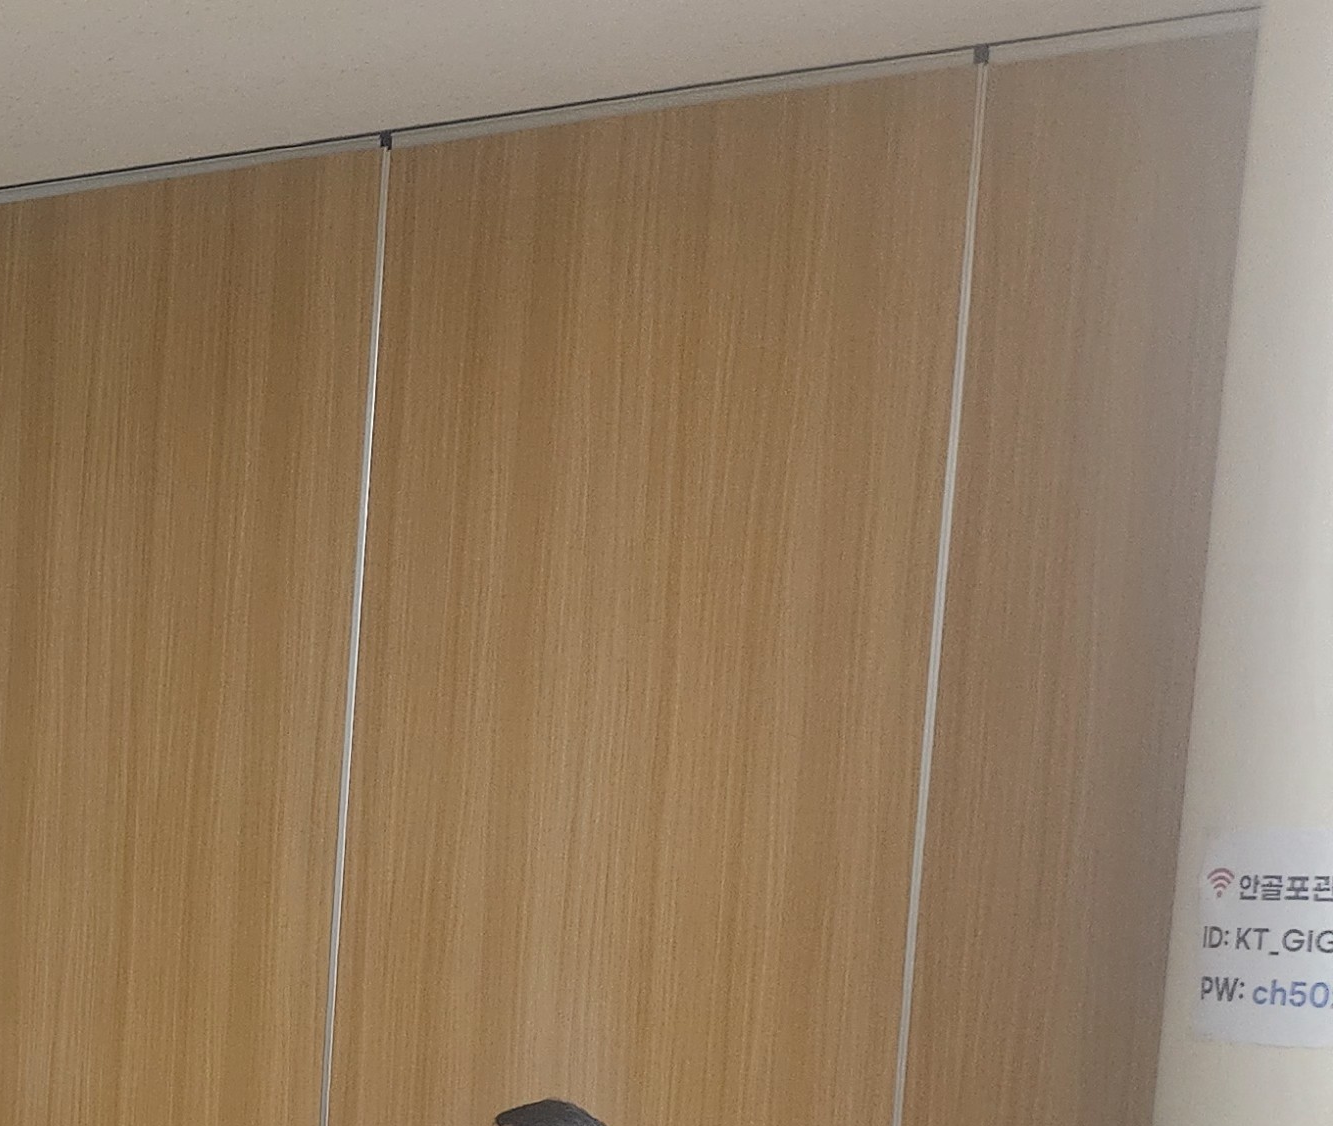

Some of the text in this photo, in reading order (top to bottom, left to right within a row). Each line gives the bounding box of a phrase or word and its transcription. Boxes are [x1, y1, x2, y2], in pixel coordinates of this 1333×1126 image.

[1201, 925, 1230, 949] ID:
[1200, 976, 1333, 1009] PW: ch50
